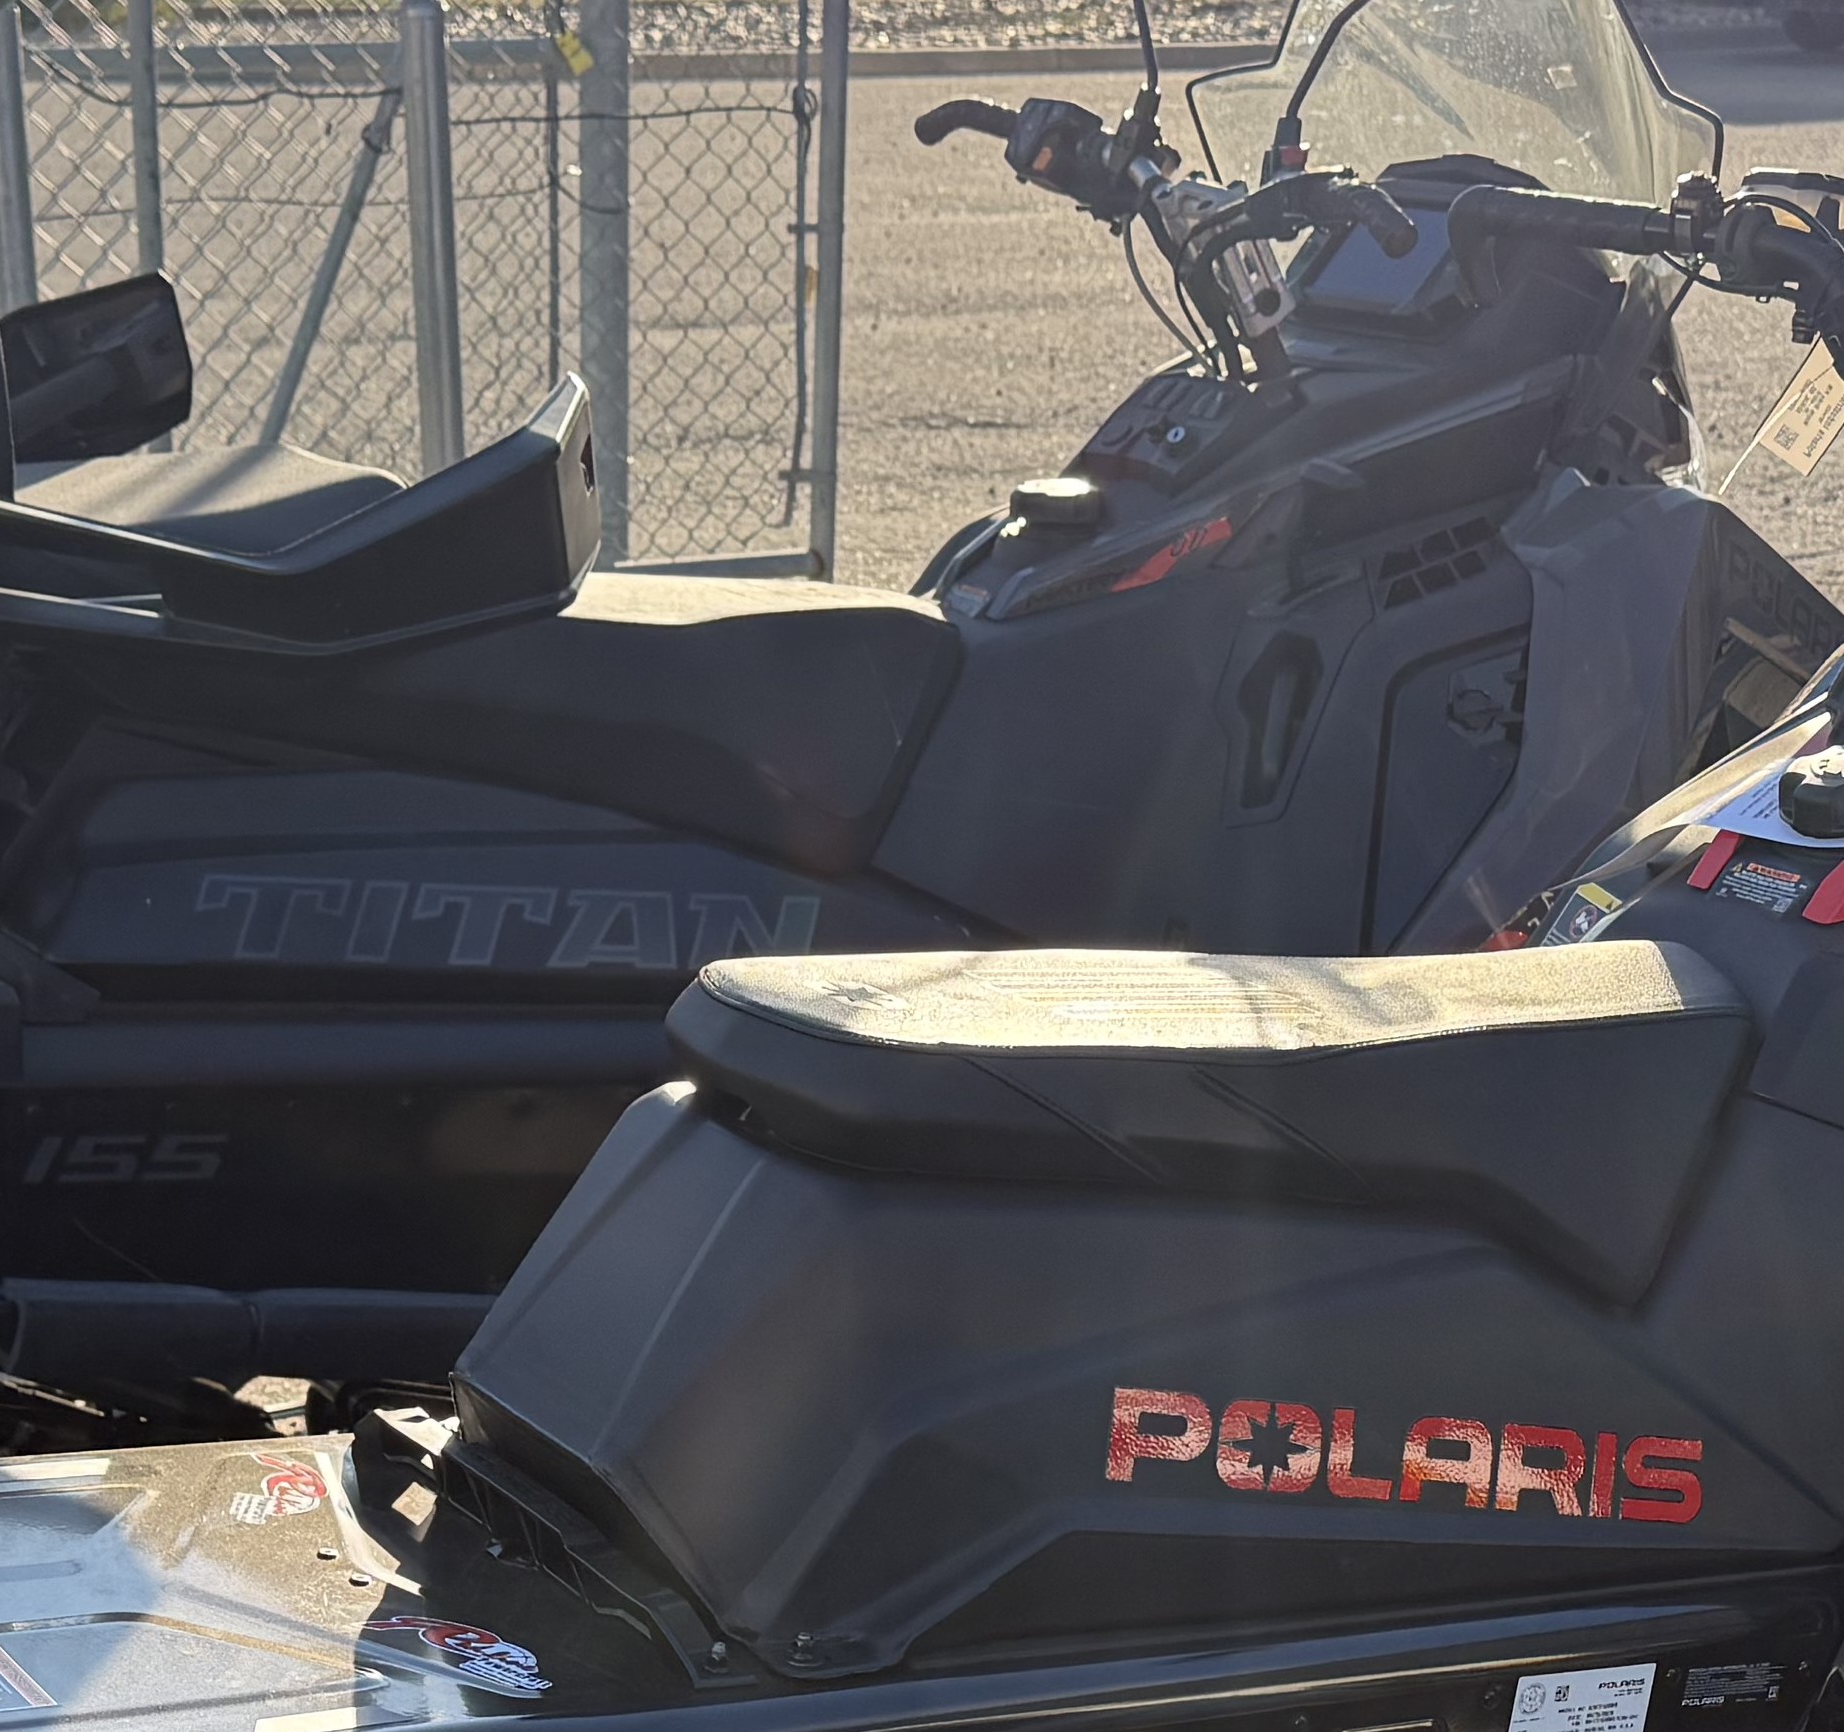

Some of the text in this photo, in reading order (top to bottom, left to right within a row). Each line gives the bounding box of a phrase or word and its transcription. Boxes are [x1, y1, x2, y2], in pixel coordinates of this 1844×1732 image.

[193, 873, 820, 970] TITAN
[23, 1133, 229, 1185] 155
[1105, 1386, 1703, 1524] POLARIS
[1598, 1677, 1645, 1690] POLARIS
